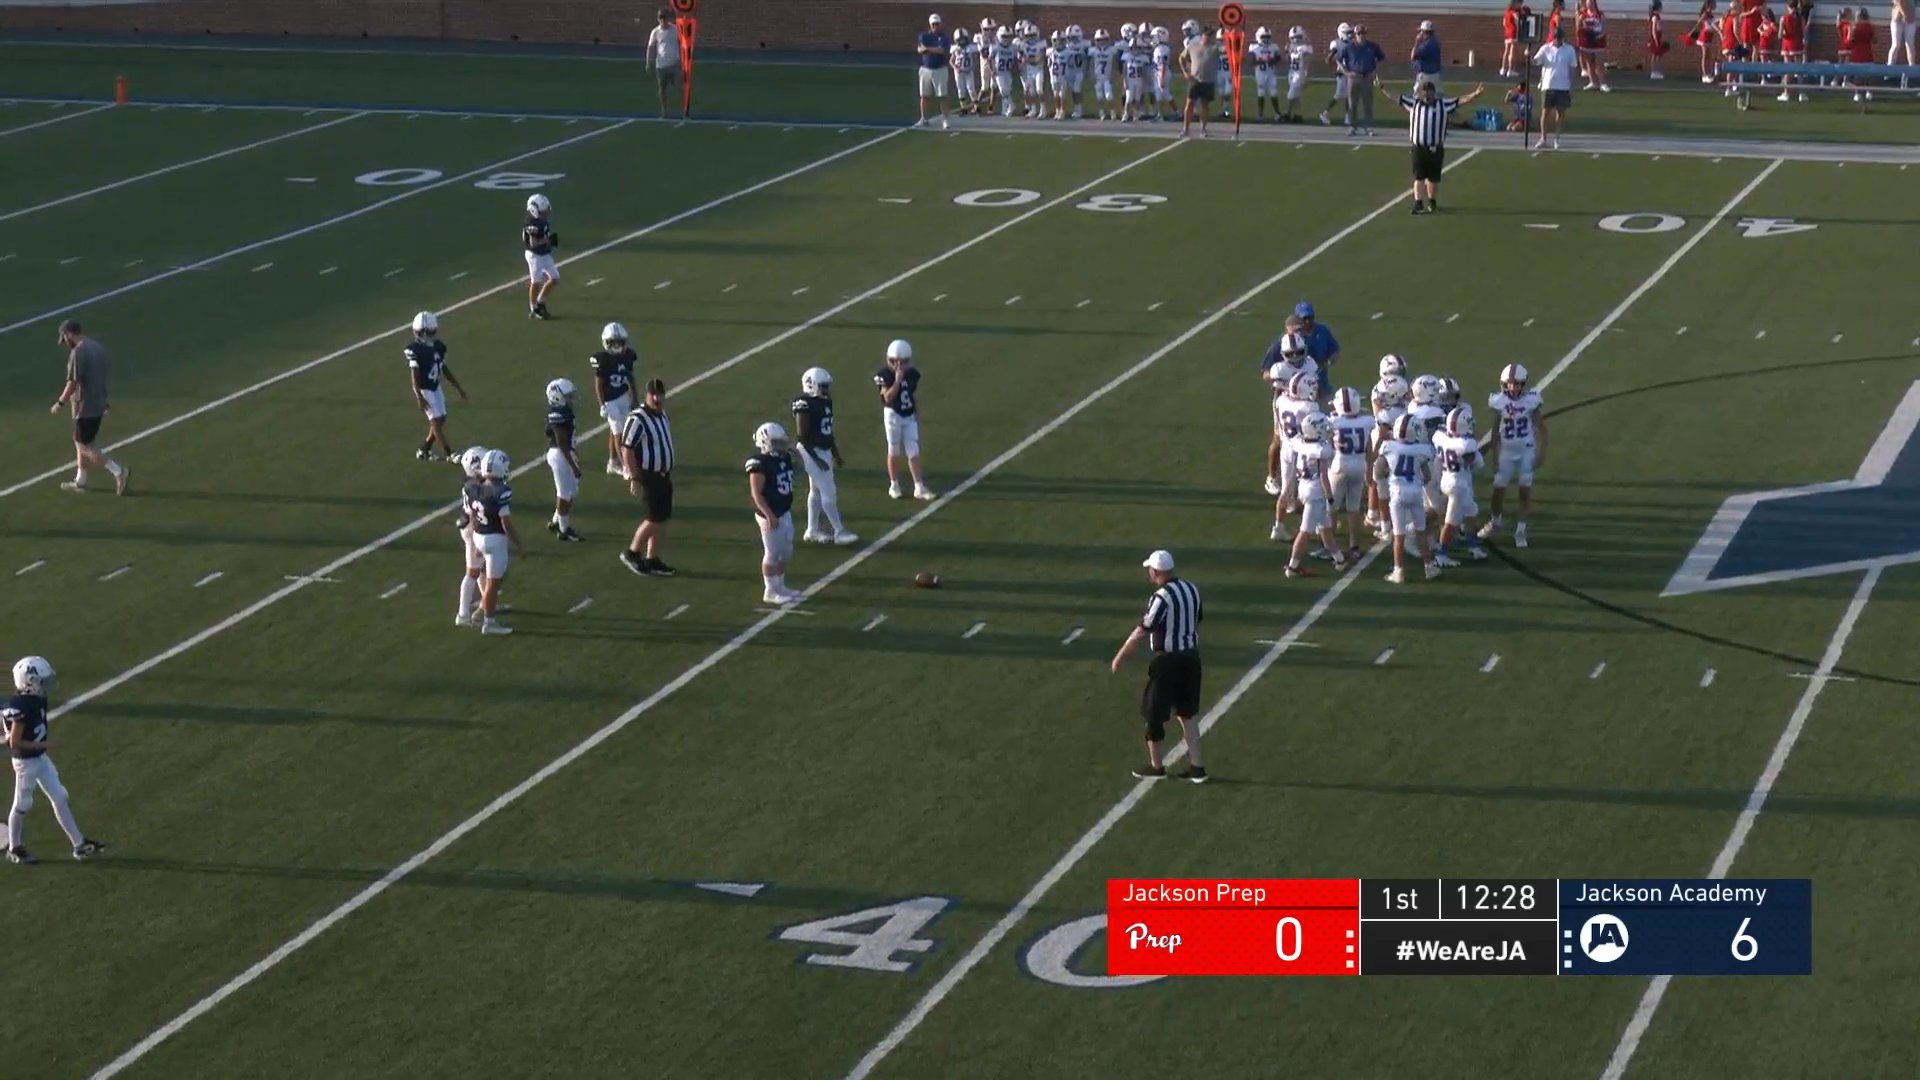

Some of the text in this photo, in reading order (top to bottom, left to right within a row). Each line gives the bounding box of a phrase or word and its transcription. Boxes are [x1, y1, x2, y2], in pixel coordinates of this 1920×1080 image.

[1526, 17, 1536, 37] 1
[428, 362, 443, 384] 4
[1503, 417, 1529, 439] 22
[1339, 427, 1365, 455] 51
[1393, 454, 1415, 483] 4
